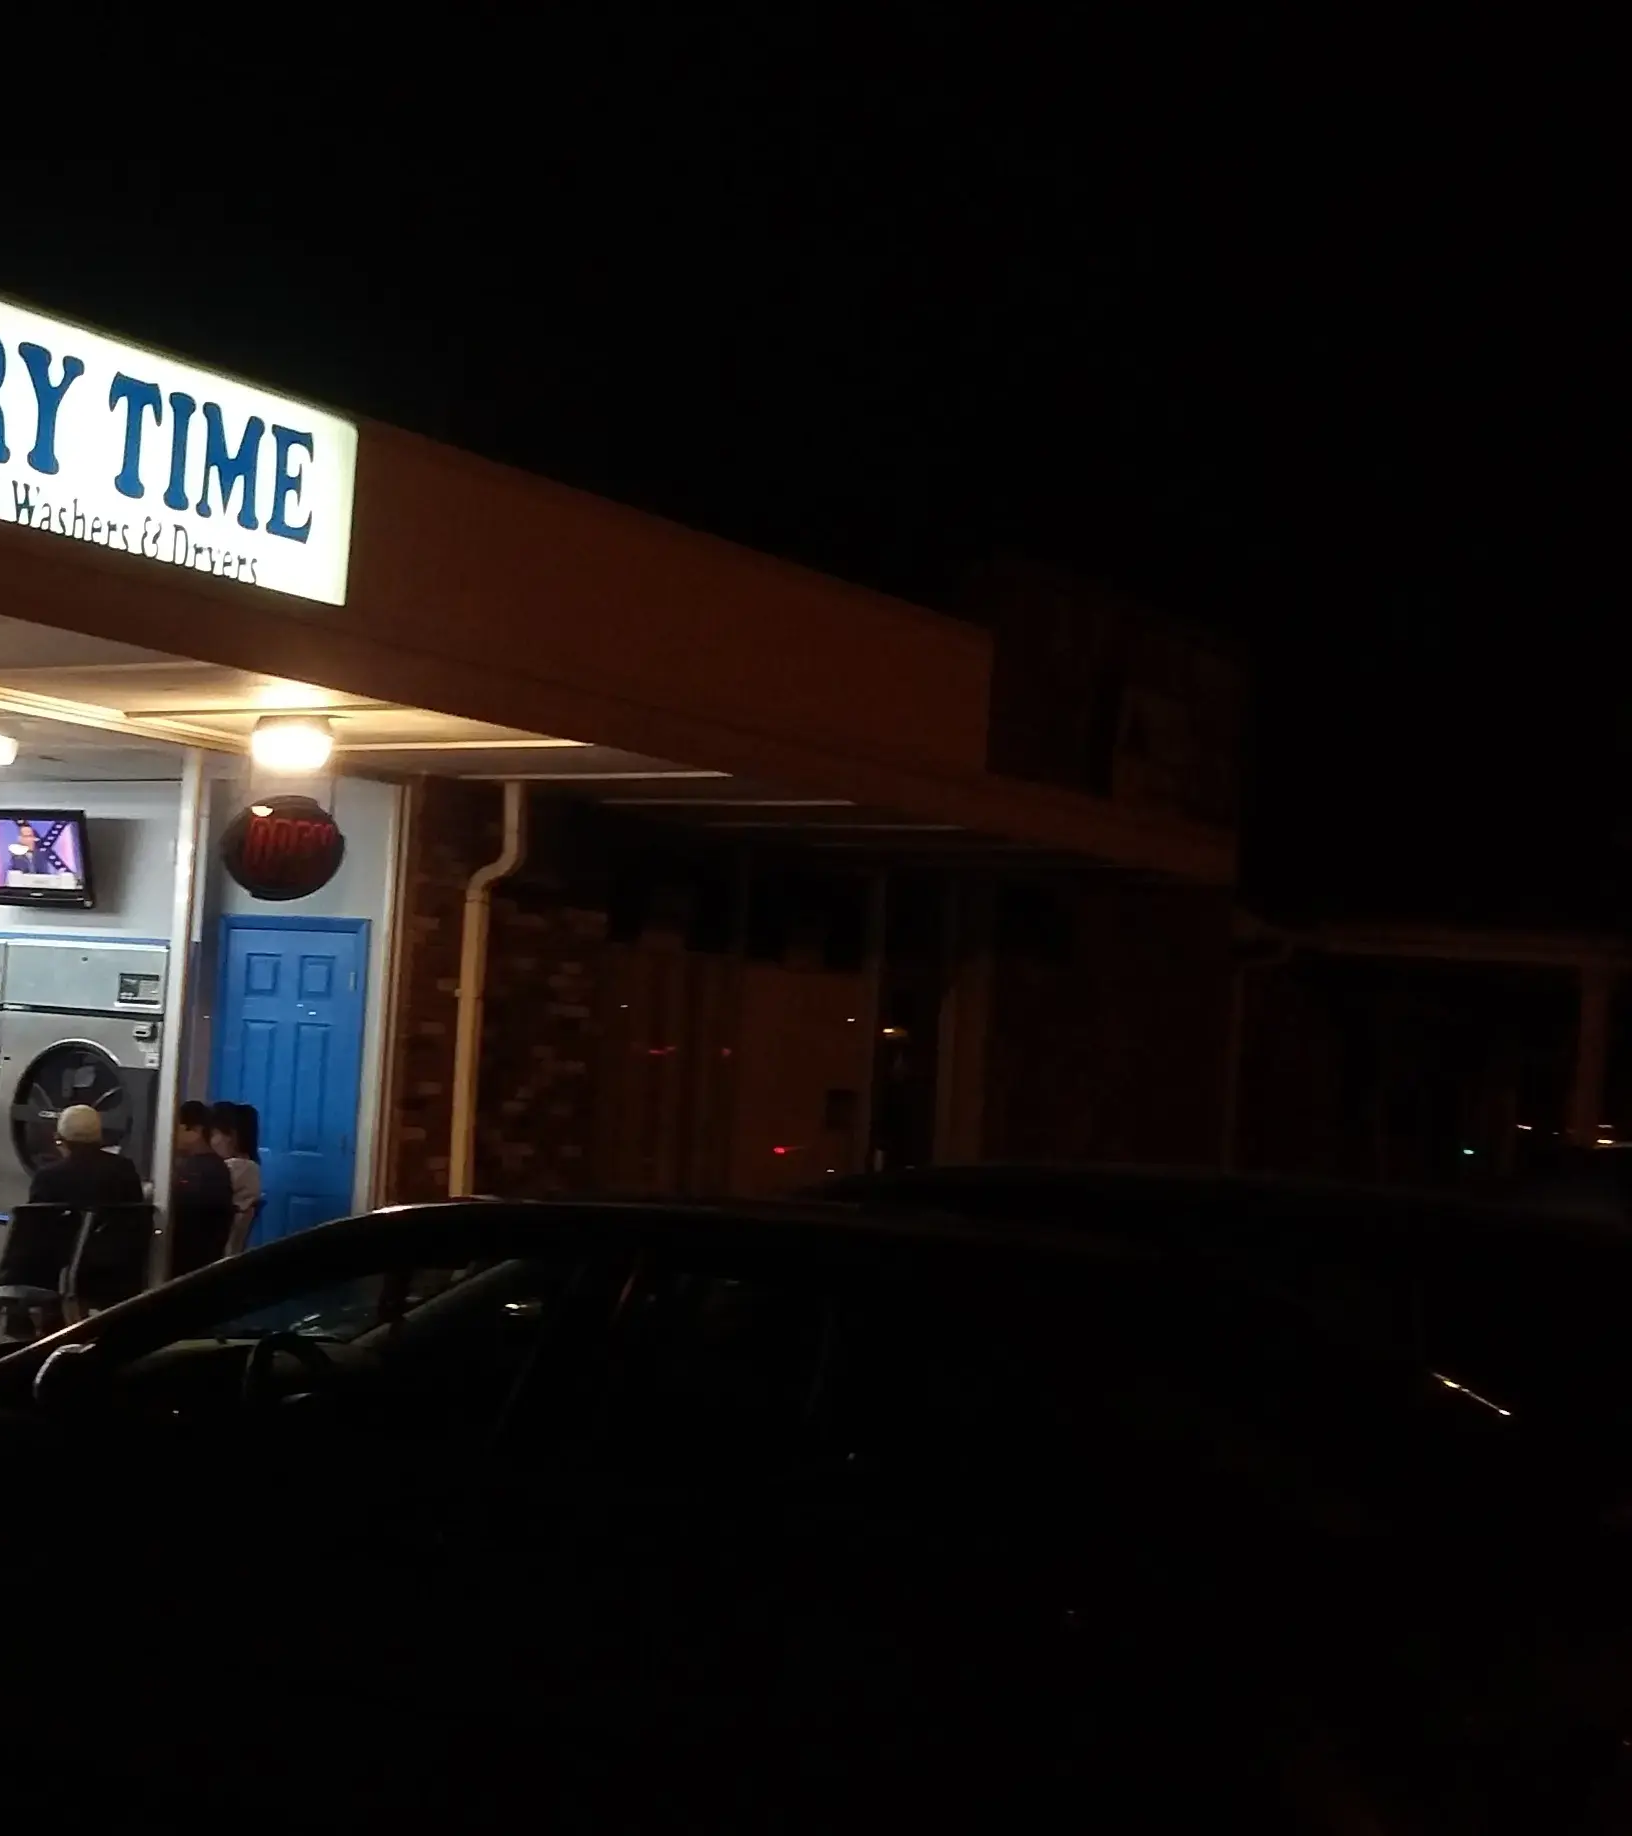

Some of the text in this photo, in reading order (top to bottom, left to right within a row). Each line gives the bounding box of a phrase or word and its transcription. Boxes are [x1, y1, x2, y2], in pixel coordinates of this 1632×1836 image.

[108, 371, 314, 544] TIME
[11, 480, 129, 552] Washers
[140, 515, 162, 558] &
[172, 523, 258, 585] Dryers
